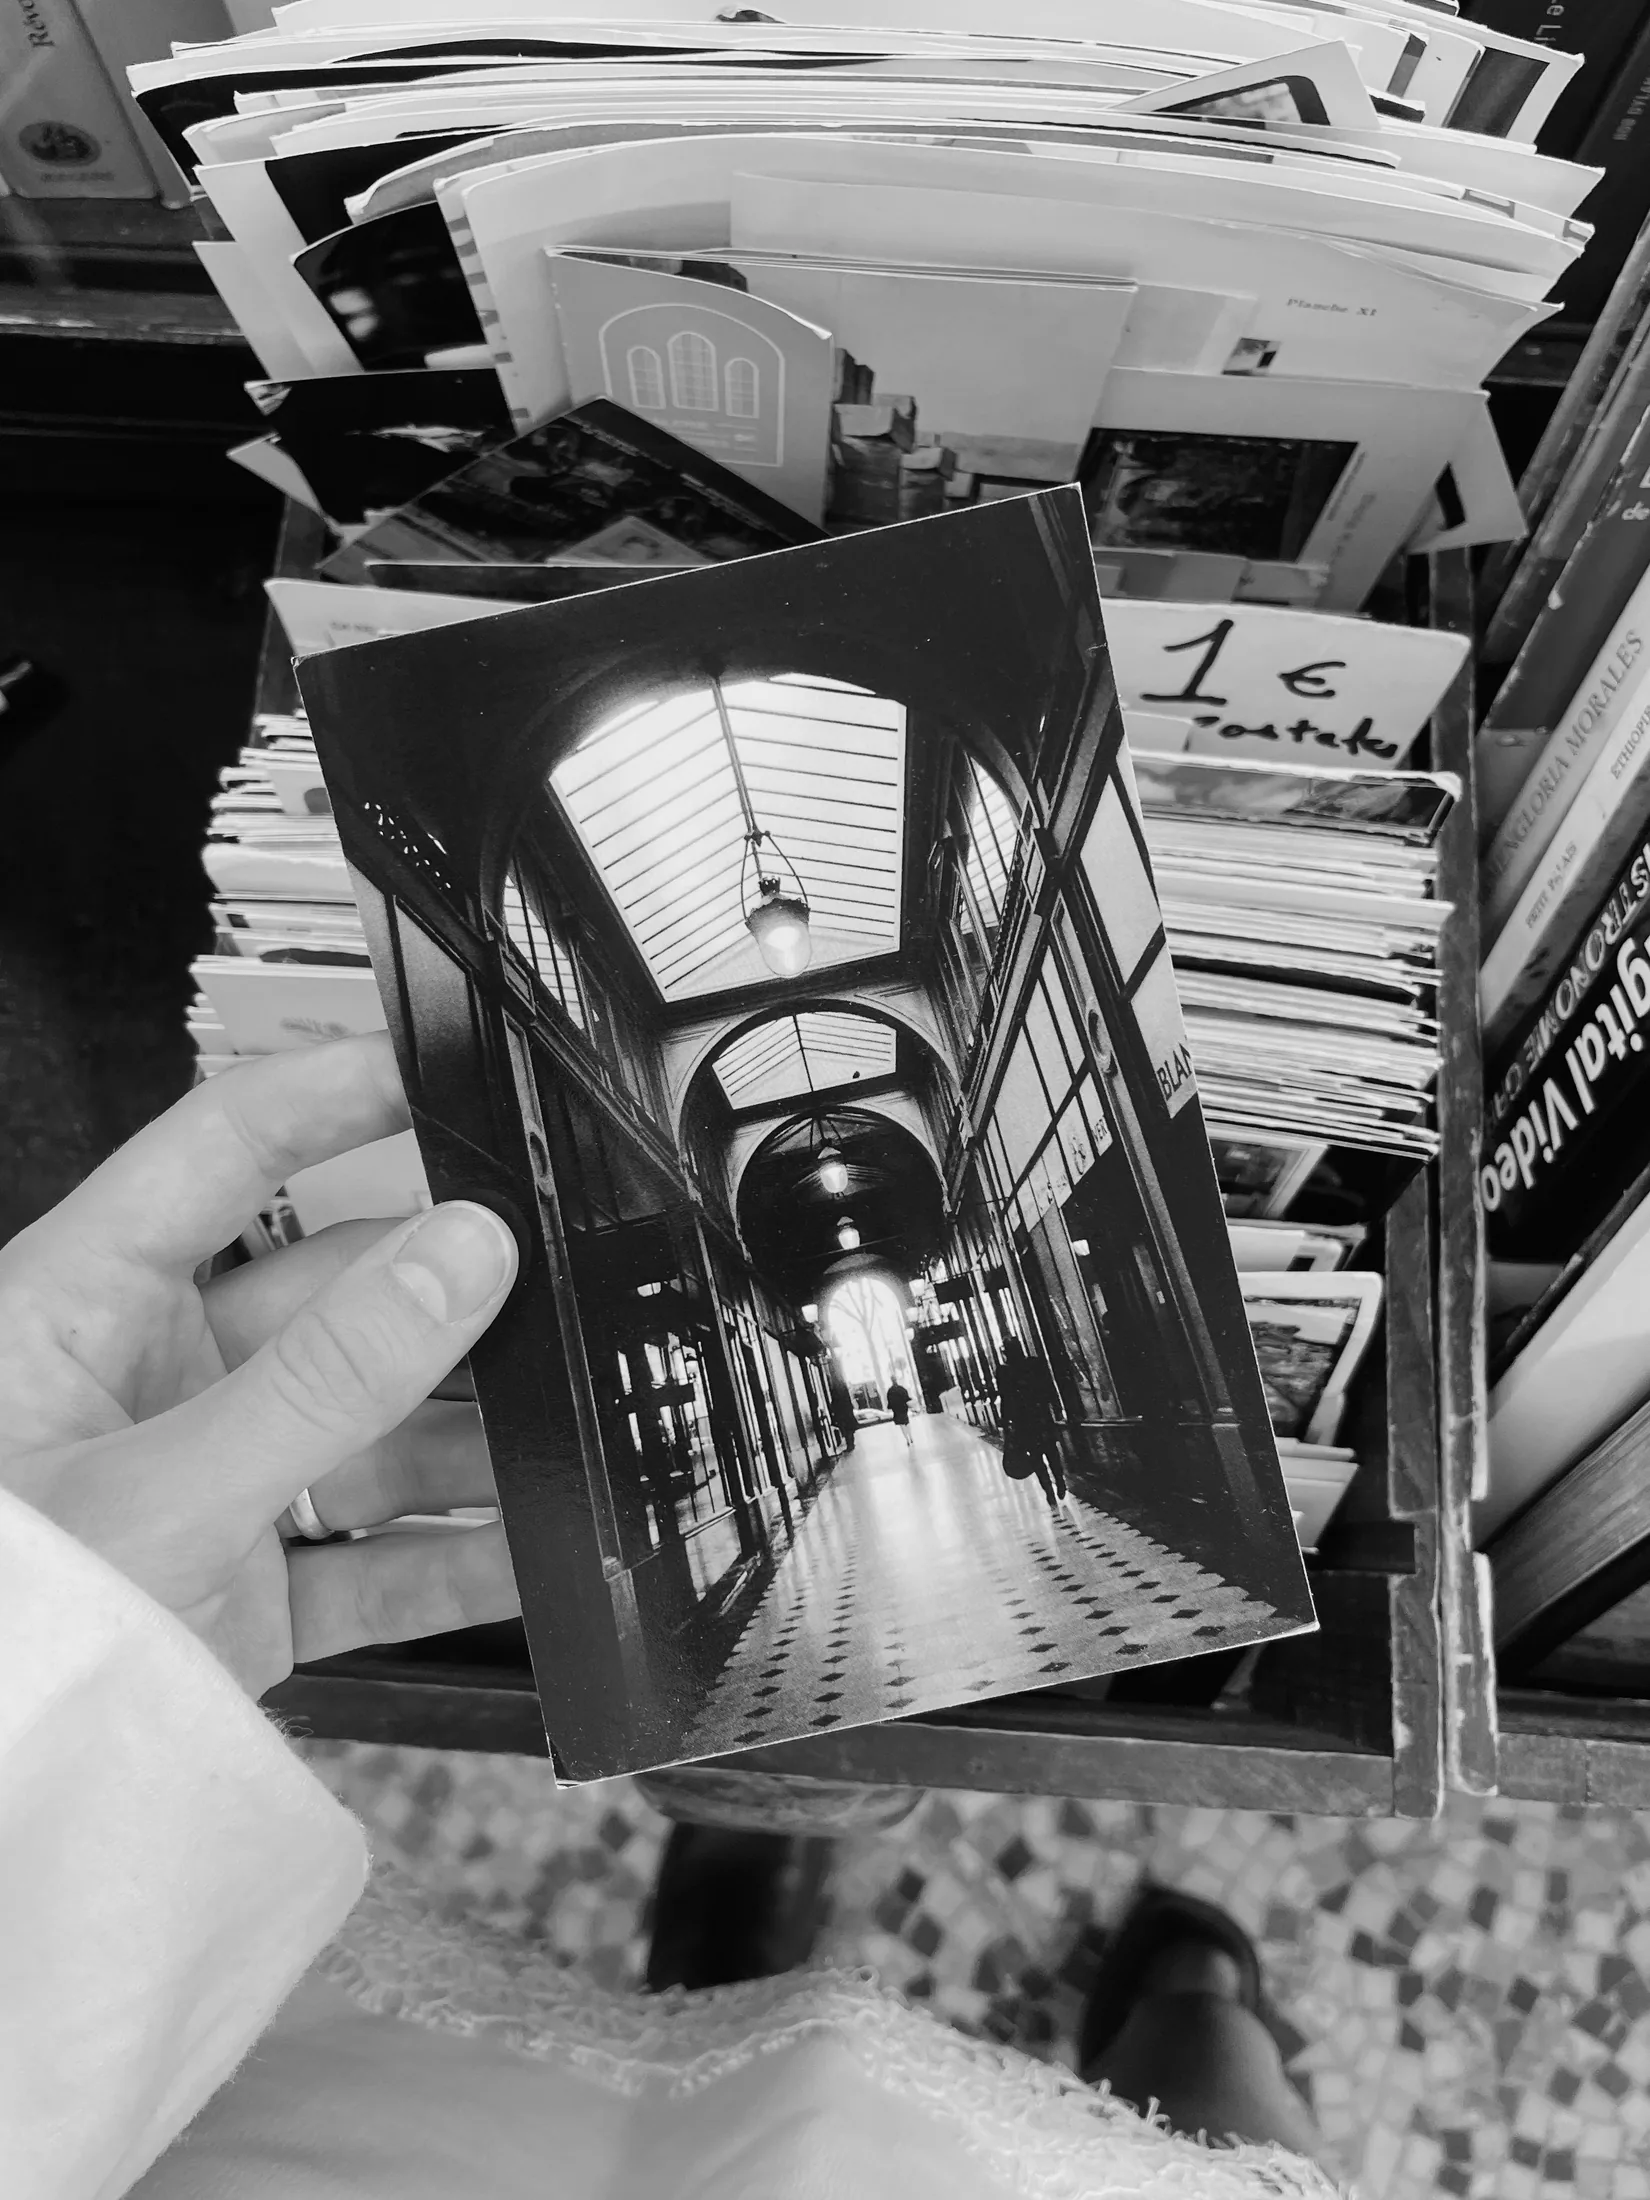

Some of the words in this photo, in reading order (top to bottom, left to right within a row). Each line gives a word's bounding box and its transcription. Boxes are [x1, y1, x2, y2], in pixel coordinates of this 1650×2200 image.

[1286, 297, 1349, 313] Planche
[1140, 619, 1235, 706] 1
[1277, 660, 1347, 699] €
[1565, 629, 1644, 757] MORALES
[1480, 1077, 1580, 1213] Video
